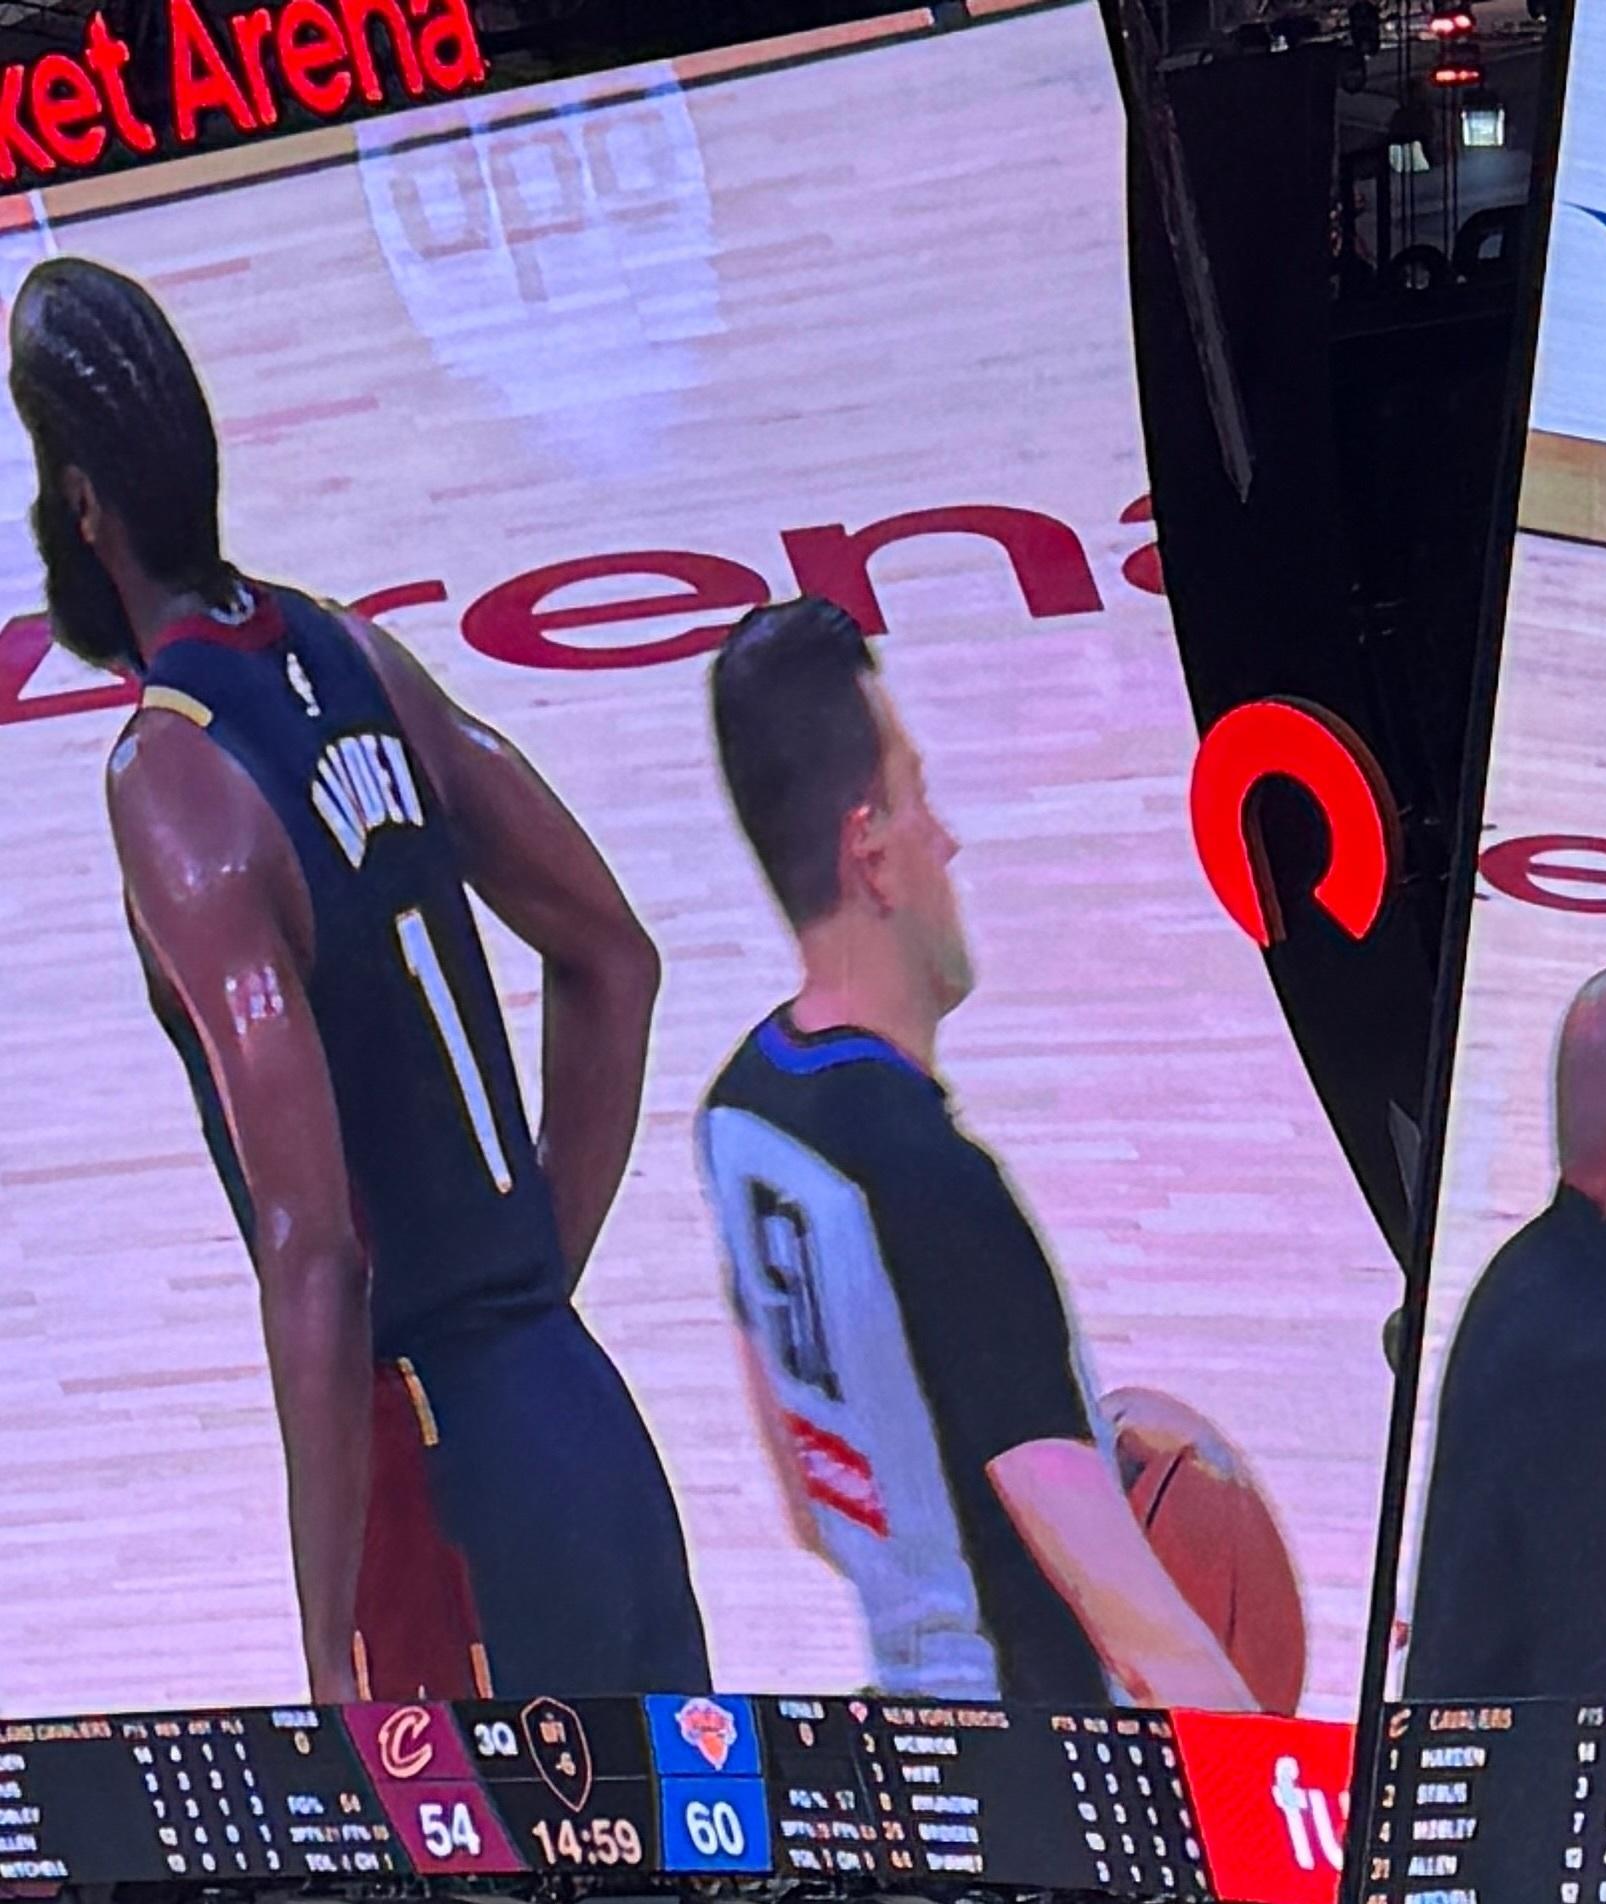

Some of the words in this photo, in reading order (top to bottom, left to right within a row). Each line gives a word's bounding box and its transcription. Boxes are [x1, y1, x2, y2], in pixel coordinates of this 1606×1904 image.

[474, 1722, 518, 1757] 3Q
[419, 1803, 480, 1857] 54
[533, 1819, 642, 1865] 14:59
[686, 1801, 744, 1856] 60
